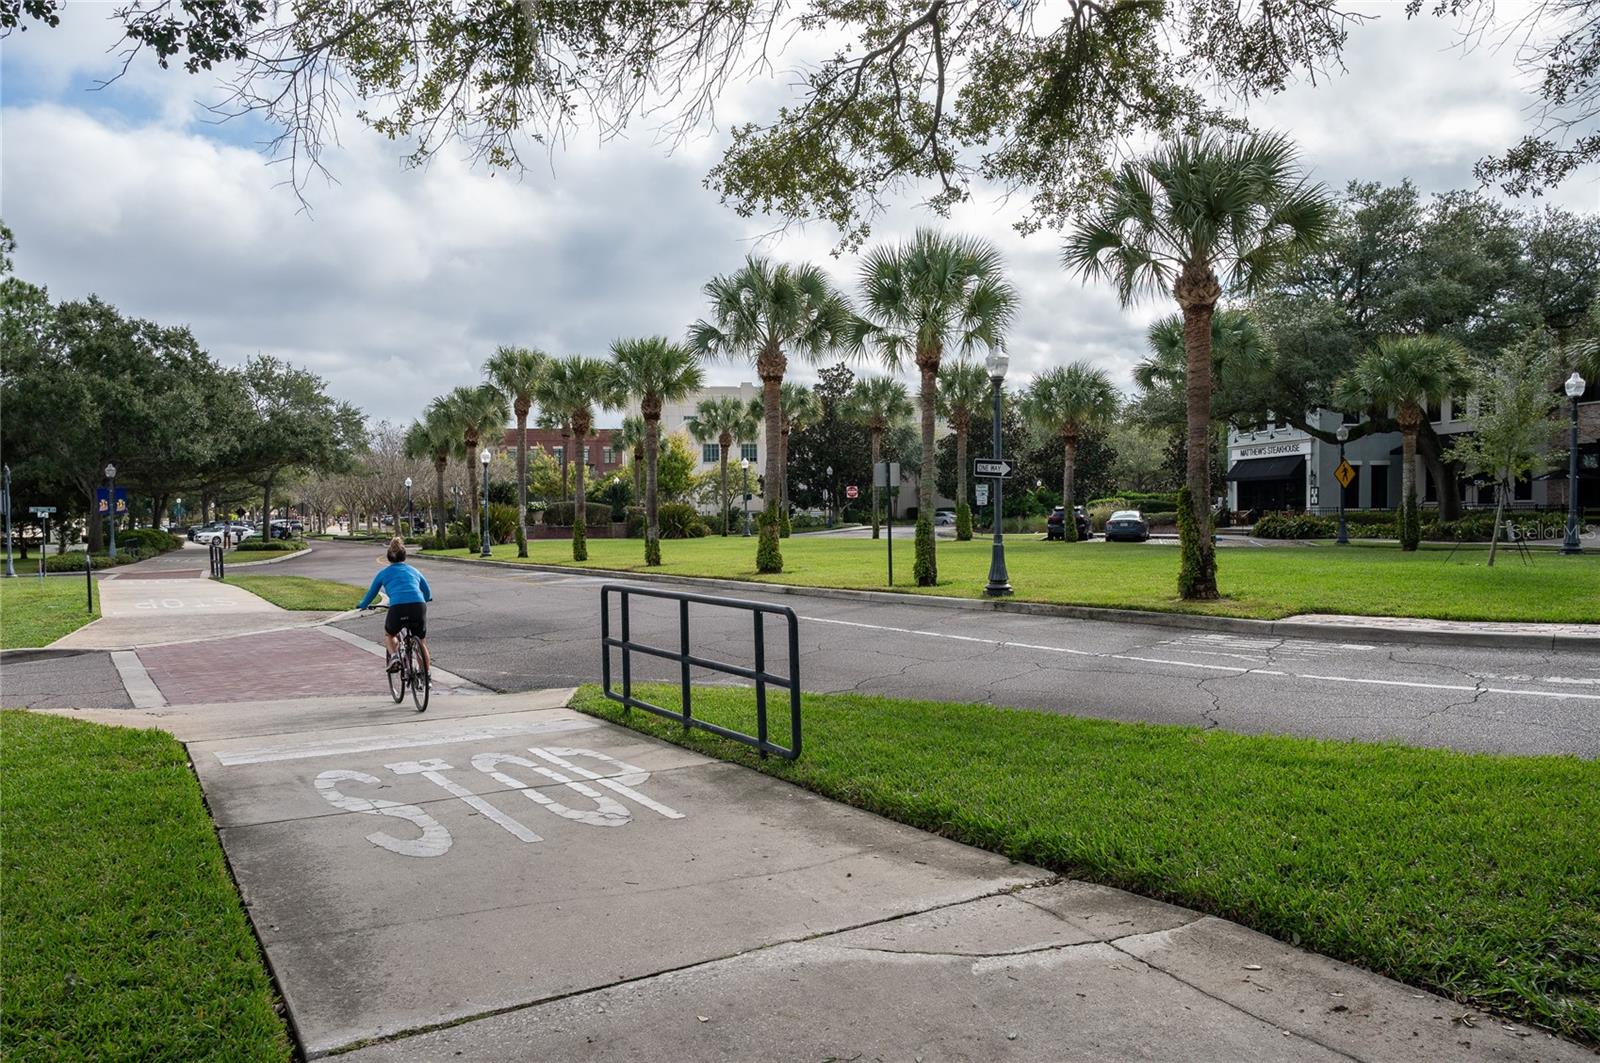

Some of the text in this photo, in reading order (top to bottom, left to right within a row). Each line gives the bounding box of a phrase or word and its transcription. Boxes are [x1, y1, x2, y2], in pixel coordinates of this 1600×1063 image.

[1240, 443, 1300, 457] MATTHEW'S STEAKHOUSE
[978, 464, 1001, 472] ONE WAY
[135, 598, 237, 609] STOP
[314, 746, 686, 858] STOP
